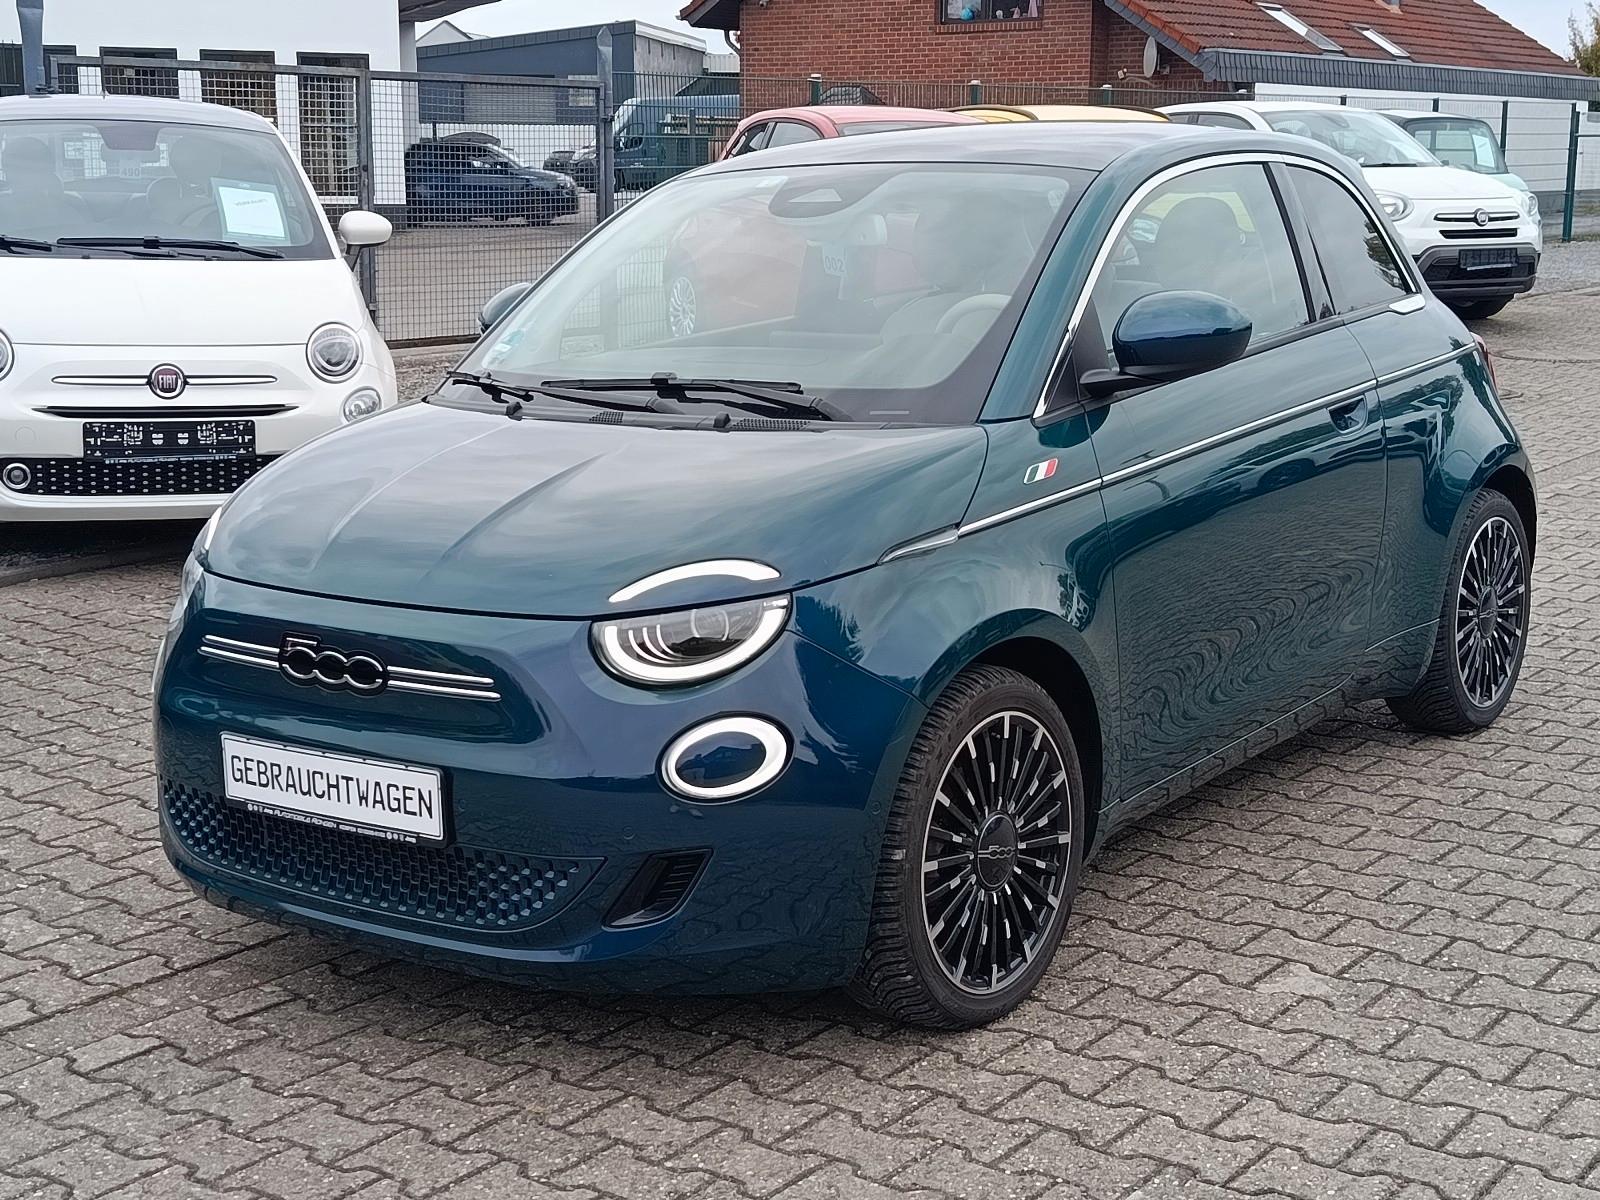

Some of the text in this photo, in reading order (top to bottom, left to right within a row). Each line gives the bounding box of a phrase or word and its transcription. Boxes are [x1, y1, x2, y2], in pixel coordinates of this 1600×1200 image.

[825, 256, 845, 273] 002
[158, 374, 177, 389] FIAT
[281, 635, 385, 691] 500
[230, 754, 434, 820] GEBRAUCHTWAGEN
[988, 845, 1015, 859] 500
